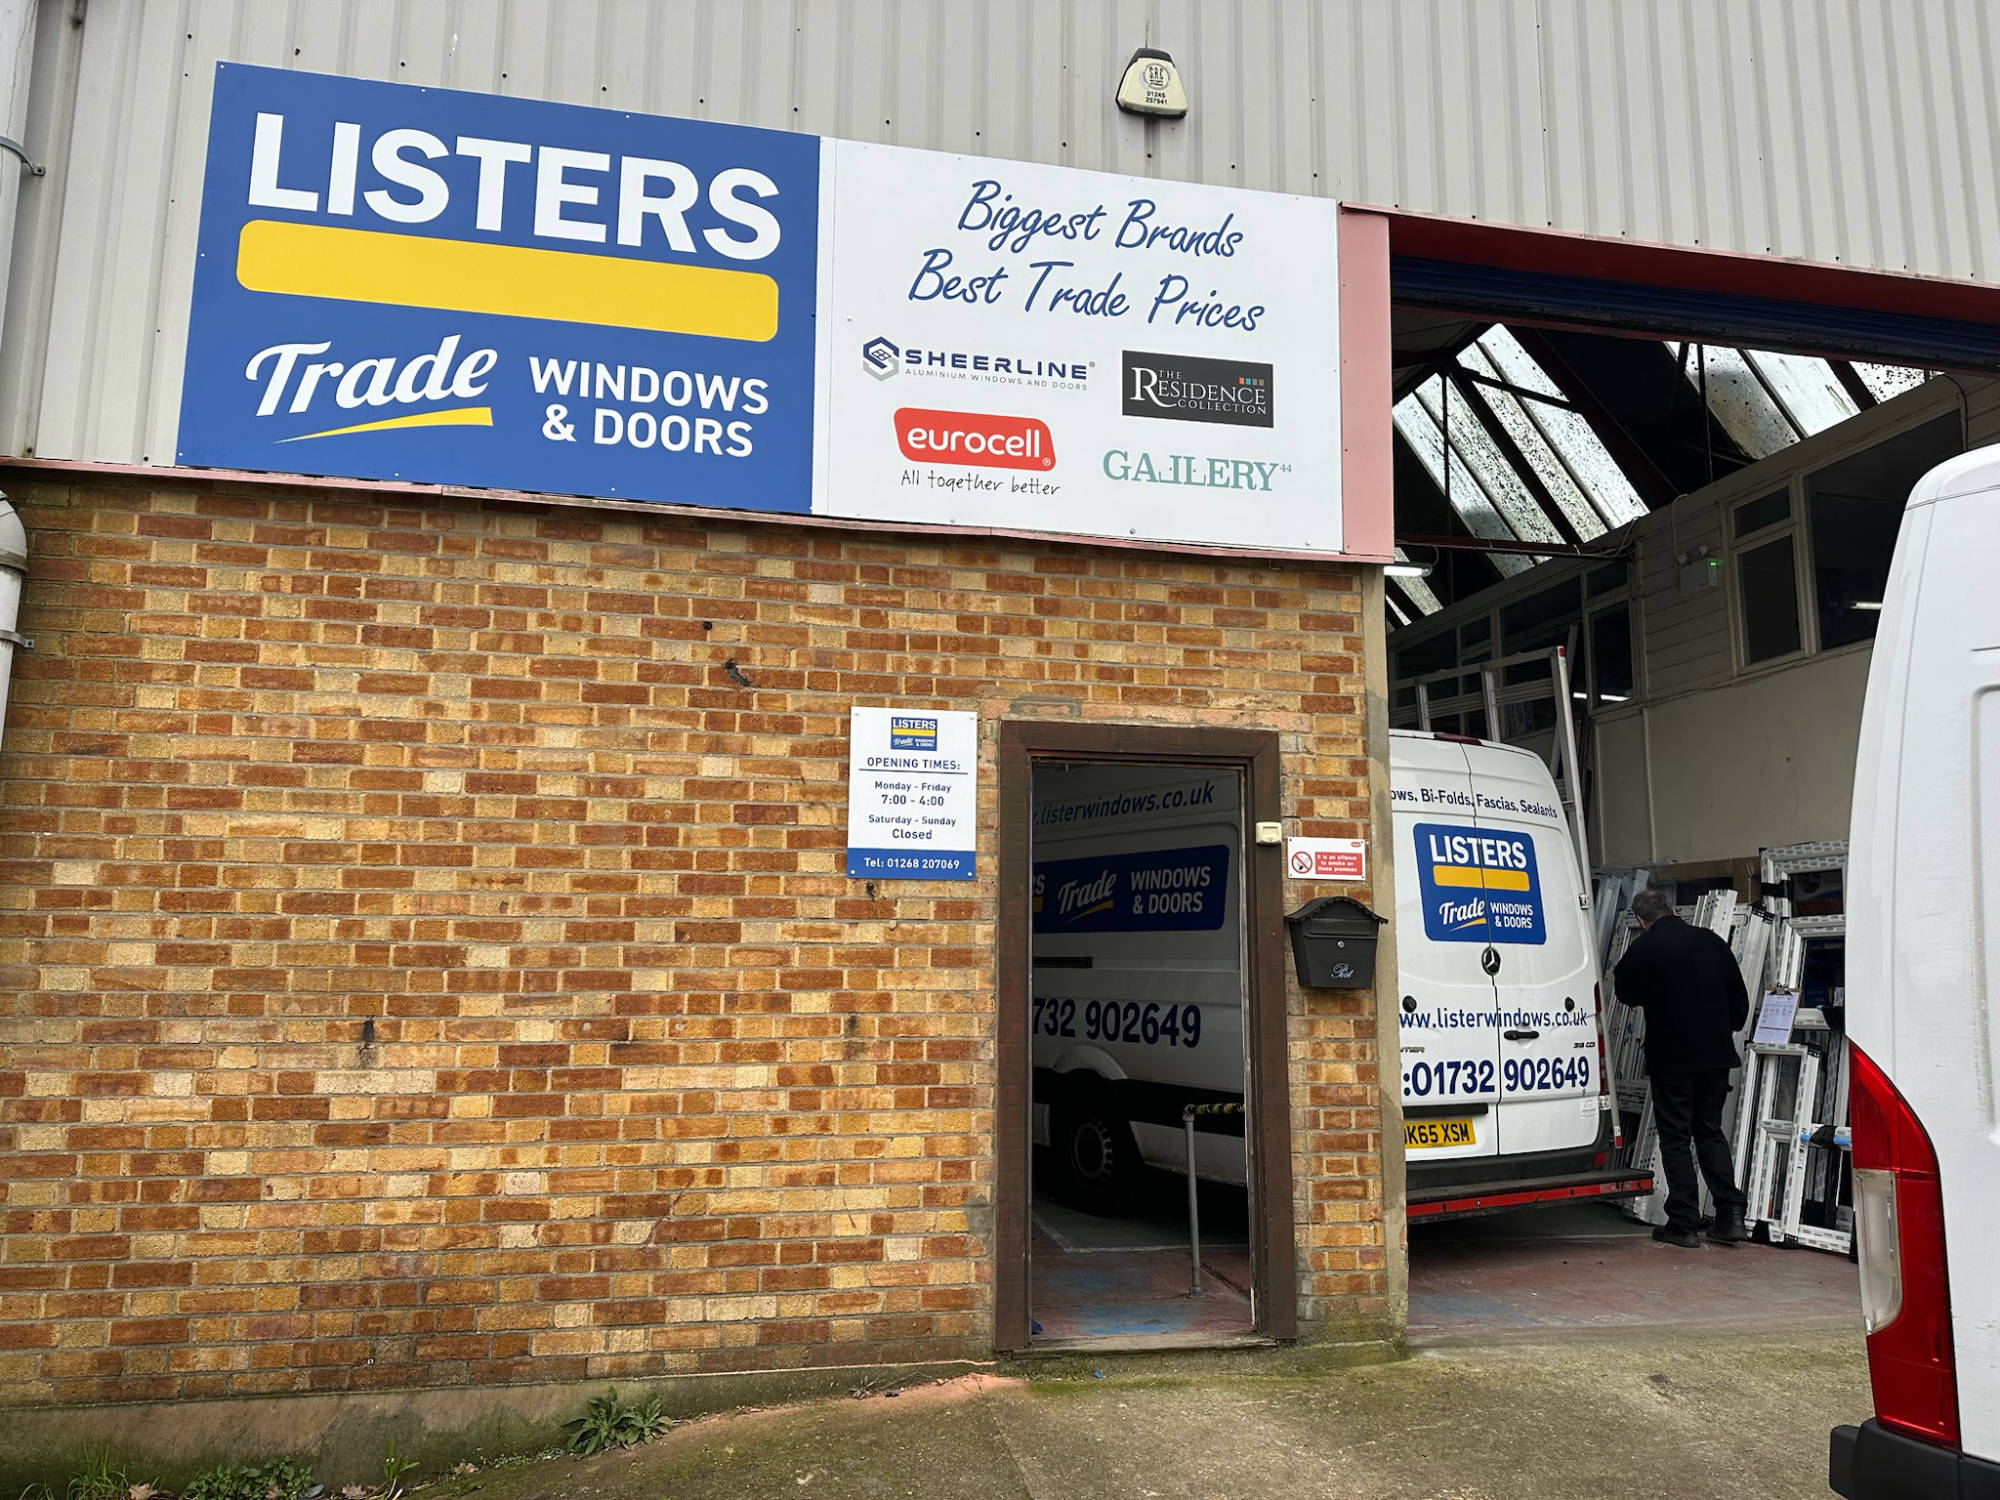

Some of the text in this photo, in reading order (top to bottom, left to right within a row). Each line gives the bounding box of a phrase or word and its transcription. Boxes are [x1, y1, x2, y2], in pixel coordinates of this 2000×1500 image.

[248, 112, 781, 260] LISTERS
[958, 180, 1243, 257] Biggest Brands
[908, 248, 1265, 331] Best Trade Prices
[245, 333, 498, 417] Trade
[905, 349, 1087, 380] SHEERLINE
[1158, 370, 1182, 379] THE
[529, 356, 769, 415] WINDOWS
[905, 368, 1088, 391] ALUMINIUM WINDOWS AND DOORS
[1130, 367, 1266, 408] RESIDENCE
[1177, 399, 1267, 415] COLLECTION
[542, 404, 753, 458] & DOORS
[907, 427, 1040, 458] eurocell
[901, 469, 1062, 496] All together better
[893, 719, 936, 730] LISTERS
[867, 757, 961, 770] OPENING TIMES:
[874, 781, 912, 792] Monday
[921, 783, 952, 794] Friday
[881, 794, 907, 805] 7:00
[919, 796, 944, 807] 4:00
[1421, 789, 1475, 807] Bi-Folds,
[1476, 793, 1519, 813] Fascias,
[1520, 800, 1558, 818] Sealants
[868, 814, 912, 826] Saturday
[921, 816, 957, 827] Sunday
[892, 828, 933, 839] Closed
[864, 857, 960, 869] Tel: 01268 207069
[1429, 834, 1527, 869] LISTERS
[1057, 868, 1117, 915] Trade
[1131, 866, 1211, 890] WINDOWS
[1132, 891, 1203, 915] & DOORS
[1439, 897, 1485, 925] Trade
[1490, 902, 1534, 916] WINDOWS
[1495, 915, 1533, 929] & DOORS
[1085, 1000, 1201, 1048] 902649
[1504, 1056, 1590, 1092] 902649
[1441, 1123, 1470, 1142] XSM
